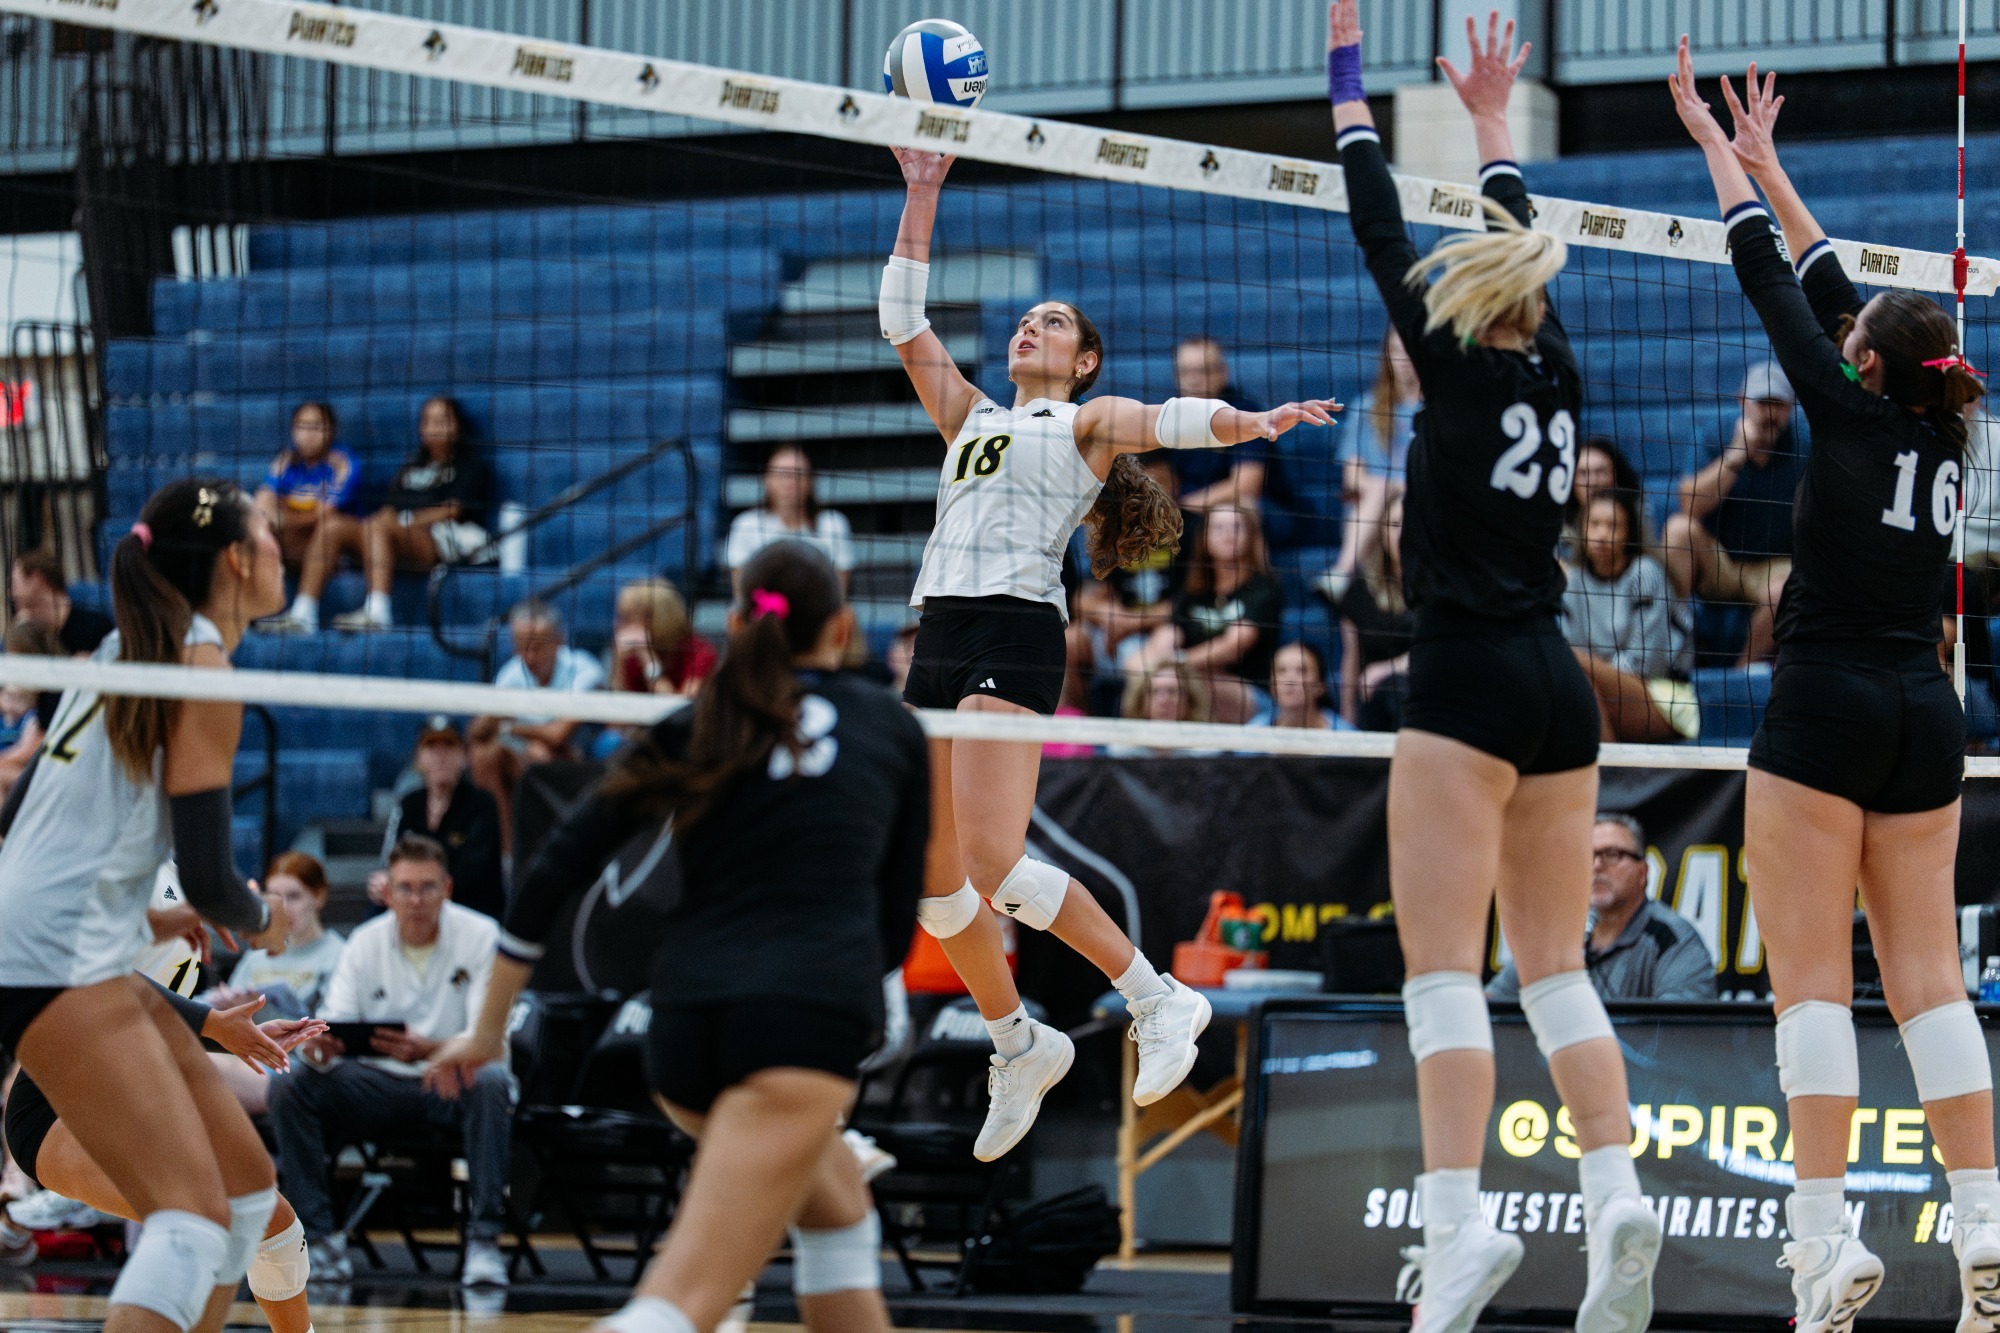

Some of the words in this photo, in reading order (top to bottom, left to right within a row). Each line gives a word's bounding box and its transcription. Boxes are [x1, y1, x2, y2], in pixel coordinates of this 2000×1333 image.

[1579, 210, 1627, 240] PIRATES
[1859, 248, 1900, 276] PIRATES
[952, 434, 1013, 484] 18
[1491, 402, 1575, 504] 23
[1881, 449, 1960, 537] 16
[1498, 1100, 1946, 1165] @SUPIRTE
